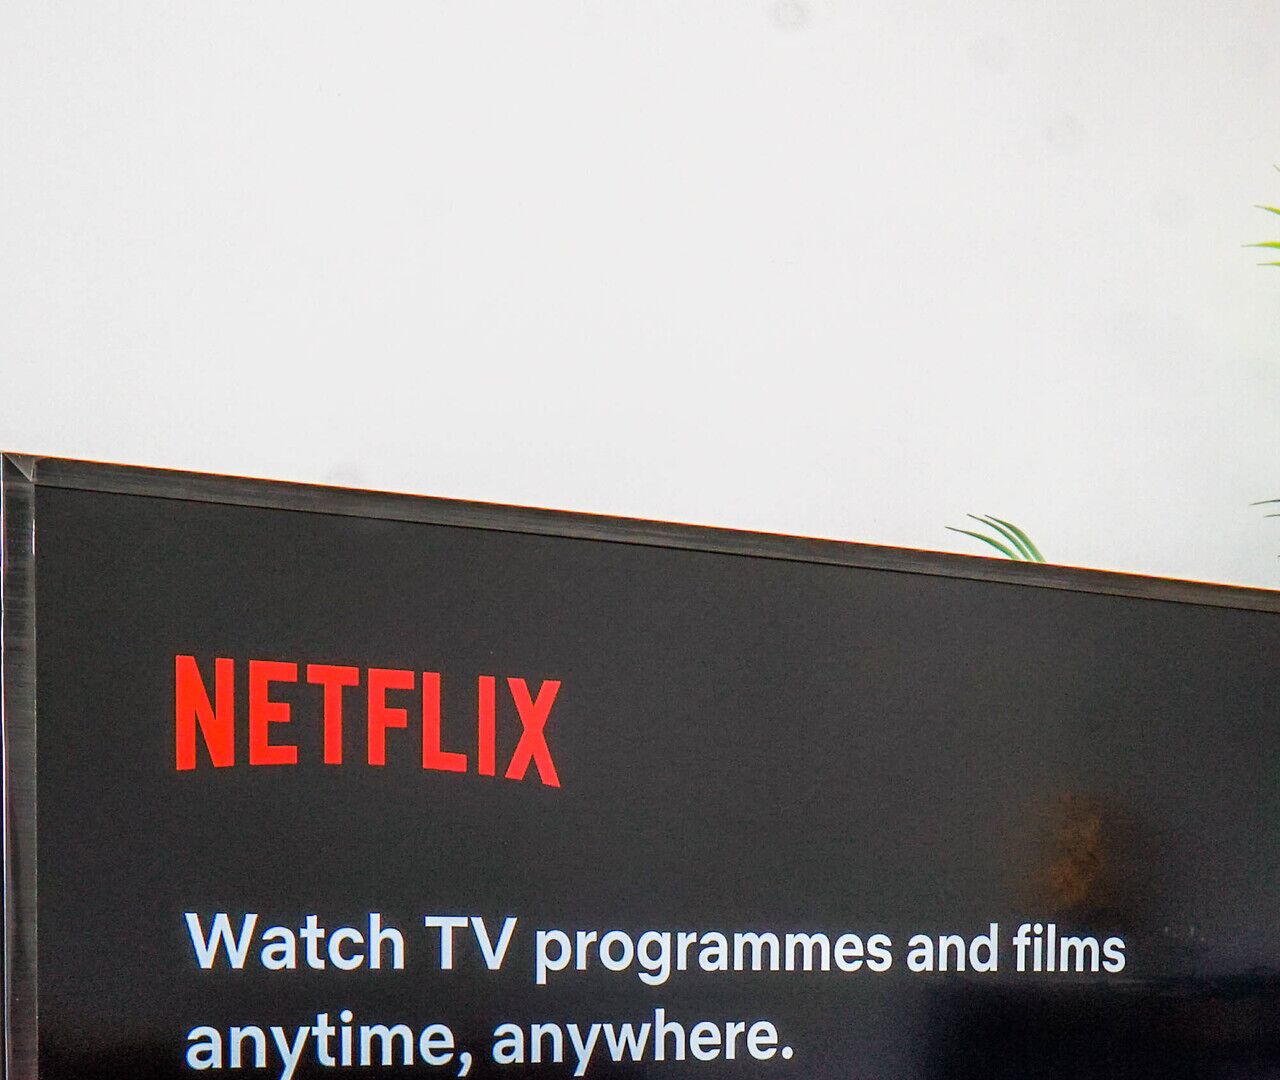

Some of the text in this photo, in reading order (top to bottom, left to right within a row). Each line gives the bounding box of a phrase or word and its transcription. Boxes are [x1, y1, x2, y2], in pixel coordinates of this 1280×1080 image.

[176, 655, 561, 788] NETFLIX
[184, 912, 1126, 986] Watch TV programmes and films
[492, 1008, 795, 1077] anywhere.
